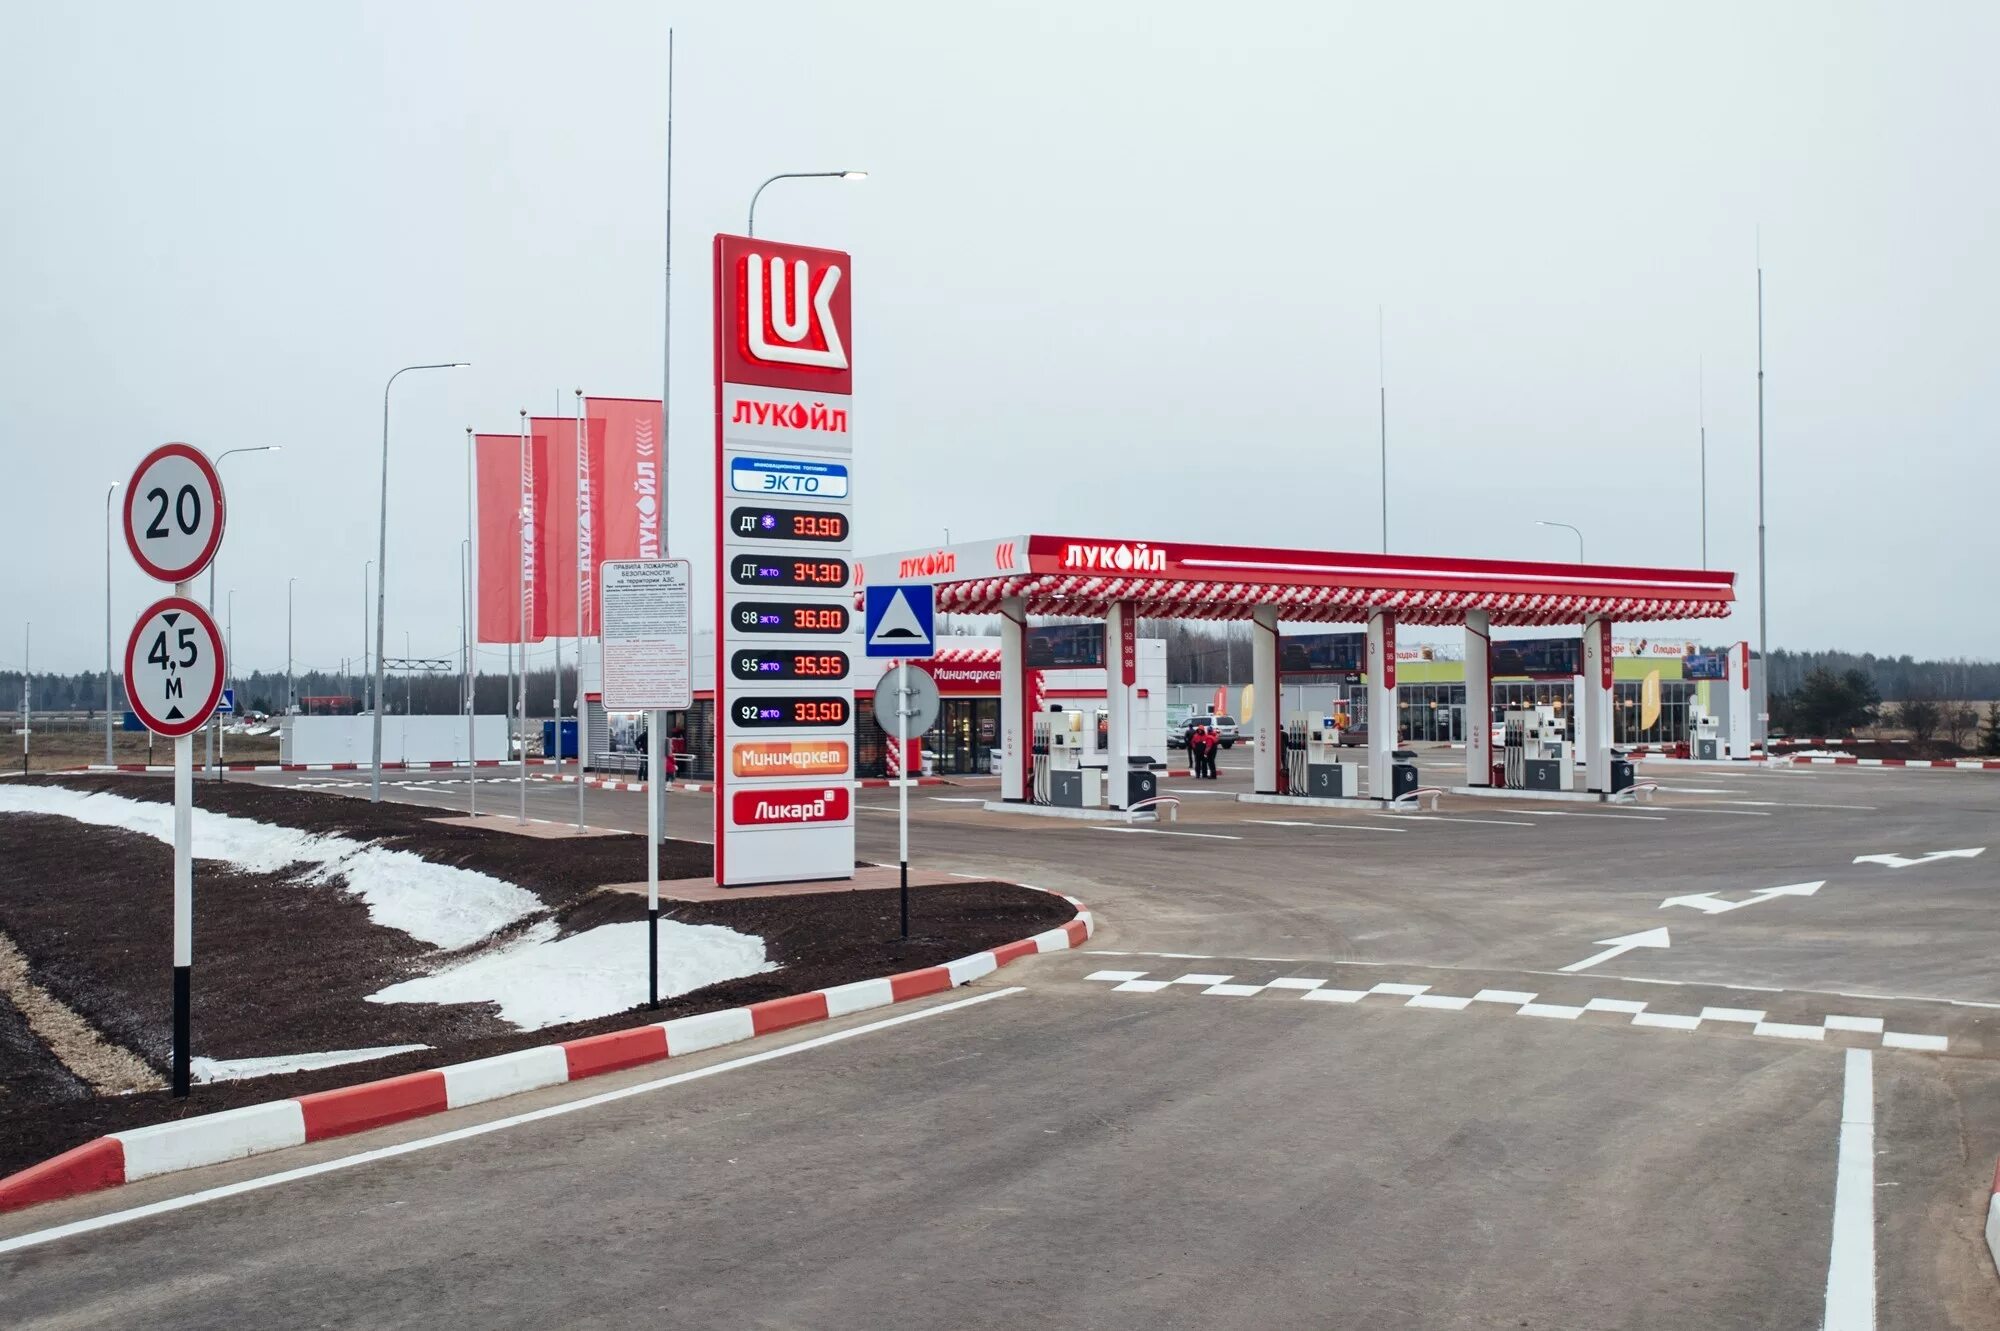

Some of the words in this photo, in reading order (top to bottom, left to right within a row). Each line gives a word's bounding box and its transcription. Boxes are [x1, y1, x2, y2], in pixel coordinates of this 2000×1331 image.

[732, 399, 847, 433] ЛУКОЙЛ
[763, 474, 819, 492] ЭКТО
[146, 483, 201, 539] 20
[634, 461, 658, 559] ЛУКОЙЛ
[740, 516, 757, 531] ДТ
[793, 516, 841, 536] 33.90
[899, 549, 957, 578] ЛУКОЙЛ
[1064, 543, 1167, 571] ЛУКОЙЛ
[741, 563, 757, 578] ДТ
[759, 568, 780, 577] ЭКТО
[793, 563, 842, 582] 34.30
[741, 611, 758, 624] 98
[759, 615, 780, 624] ЭКТО
[794, 609, 842, 628] 36.80
[148, 628, 198, 675] 4,5
[741, 658, 758, 672] 95
[759, 662, 780, 671] ЭКТО
[794, 656, 842, 676] 35.95
[741, 705, 758, 719] 92
[760, 709, 780, 718] ЭКТО
[794, 703, 842, 721] 33.50
[742, 750, 840, 769] Минимаркет
[1321, 773, 1328, 786] 3
[1538, 768, 1546, 780] 5
[1062, 781, 1069, 795] 1
[754, 799, 826, 821] Ликард
